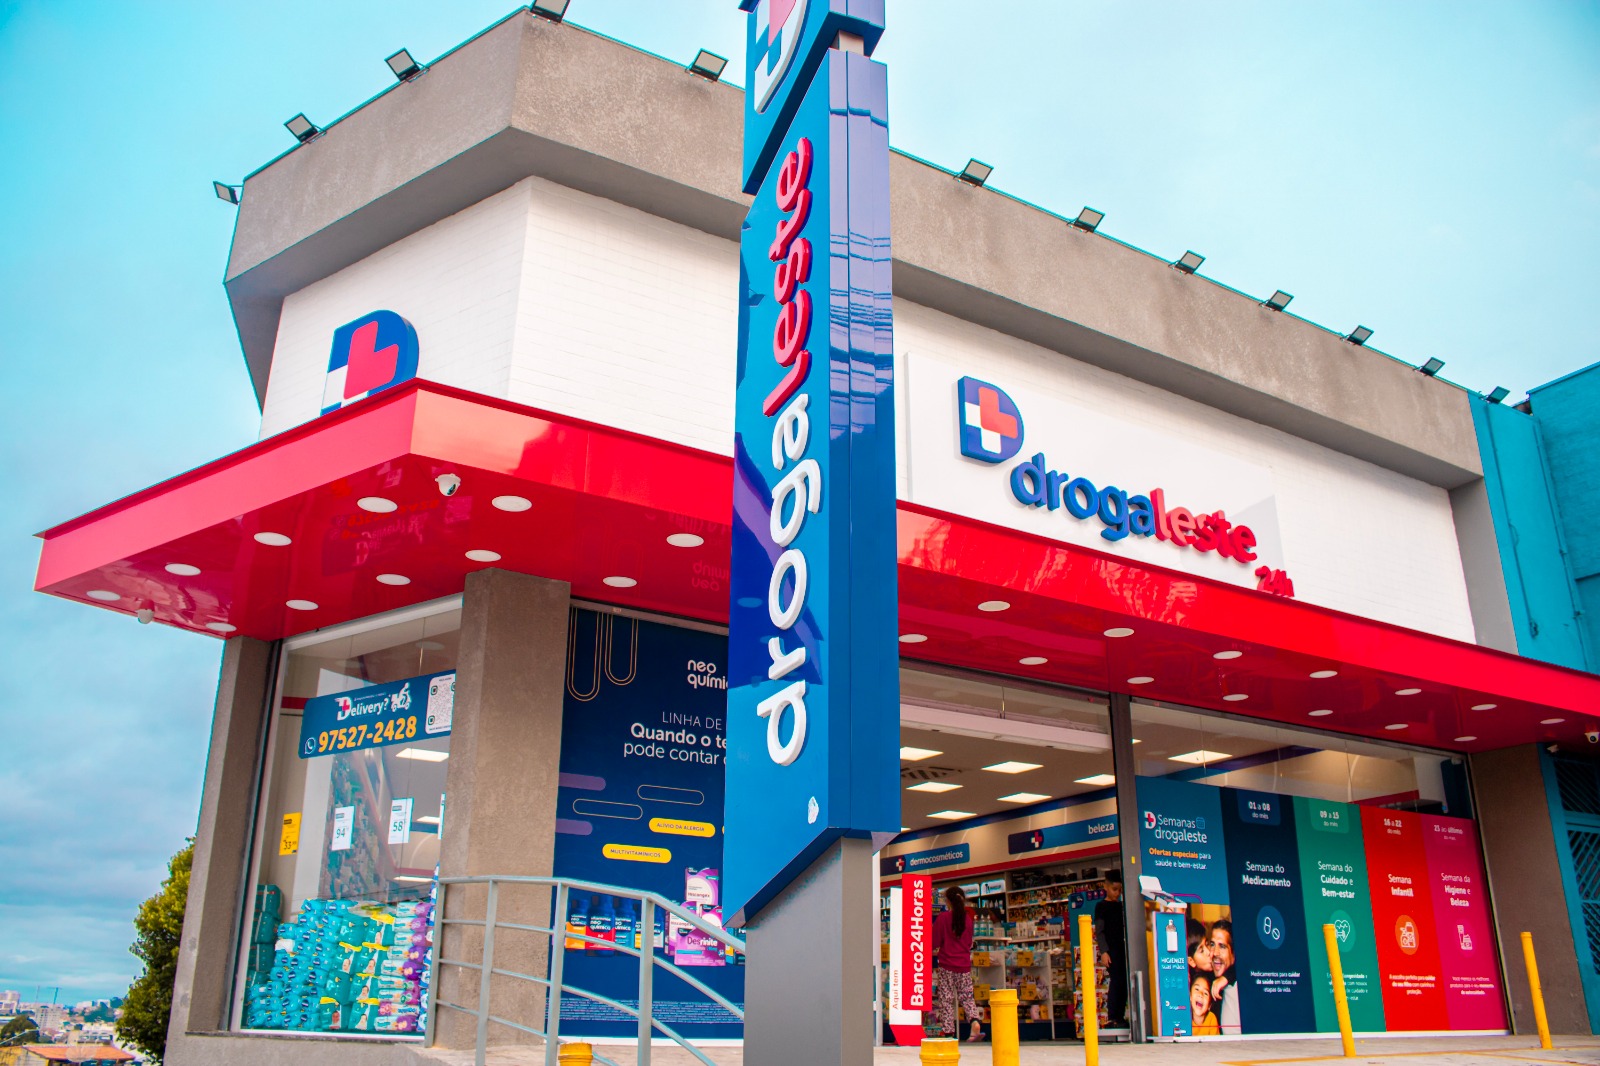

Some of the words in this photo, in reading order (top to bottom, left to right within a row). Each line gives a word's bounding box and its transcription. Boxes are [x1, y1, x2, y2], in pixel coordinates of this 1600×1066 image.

[757, 137, 820, 766] drogaleste
[1010, 452, 1257, 563] drogaleste
[687, 660, 717, 674] neo
[687, 673, 728, 690] quími
[662, 711, 702, 727] LINHA
[705, 717, 722, 730] DE
[318, 715, 417, 753] 97527-2428
[630, 722, 697, 745] Quando
[701, 735, 712, 747] o
[623, 742, 665, 758] pode
[669, 749, 720, 765] contar
[1248, 801, 1257, 810] 01
[1262, 802, 1271, 812] 08
[1088, 821, 1115, 835] beleza
[1157, 814, 1196, 829] Semanas
[1155, 825, 1208, 844] drogaleste
[909, 850, 964, 867] dermocosméticos
[1149, 847, 1172, 857] Ofertas
[1172, 851, 1199, 859] especiais
[1199, 852, 1212, 860] para
[1155, 859, 1172, 868] saúde
[1246, 861, 1274, 873] Semana
[1275, 863, 1285, 874] do
[1317, 861, 1343, 872] Semana
[1344, 864, 1353, 873] do
[1242, 874, 1291, 888] Medicamento
[1320, 874, 1348, 885] Cuidado
[1388, 873, 1412, 885] Semana
[1441, 872, 1463, 883] Semana
[1464, 875, 1471, 883] da
[1321, 887, 1355, 899] Bem-estar
[1391, 886, 1414, 897] Infantil
[1444, 884, 1466, 896] Higiene
[687, 936, 718, 947] Desrinite
[910, 879, 924, 1007] Banco24Horas
